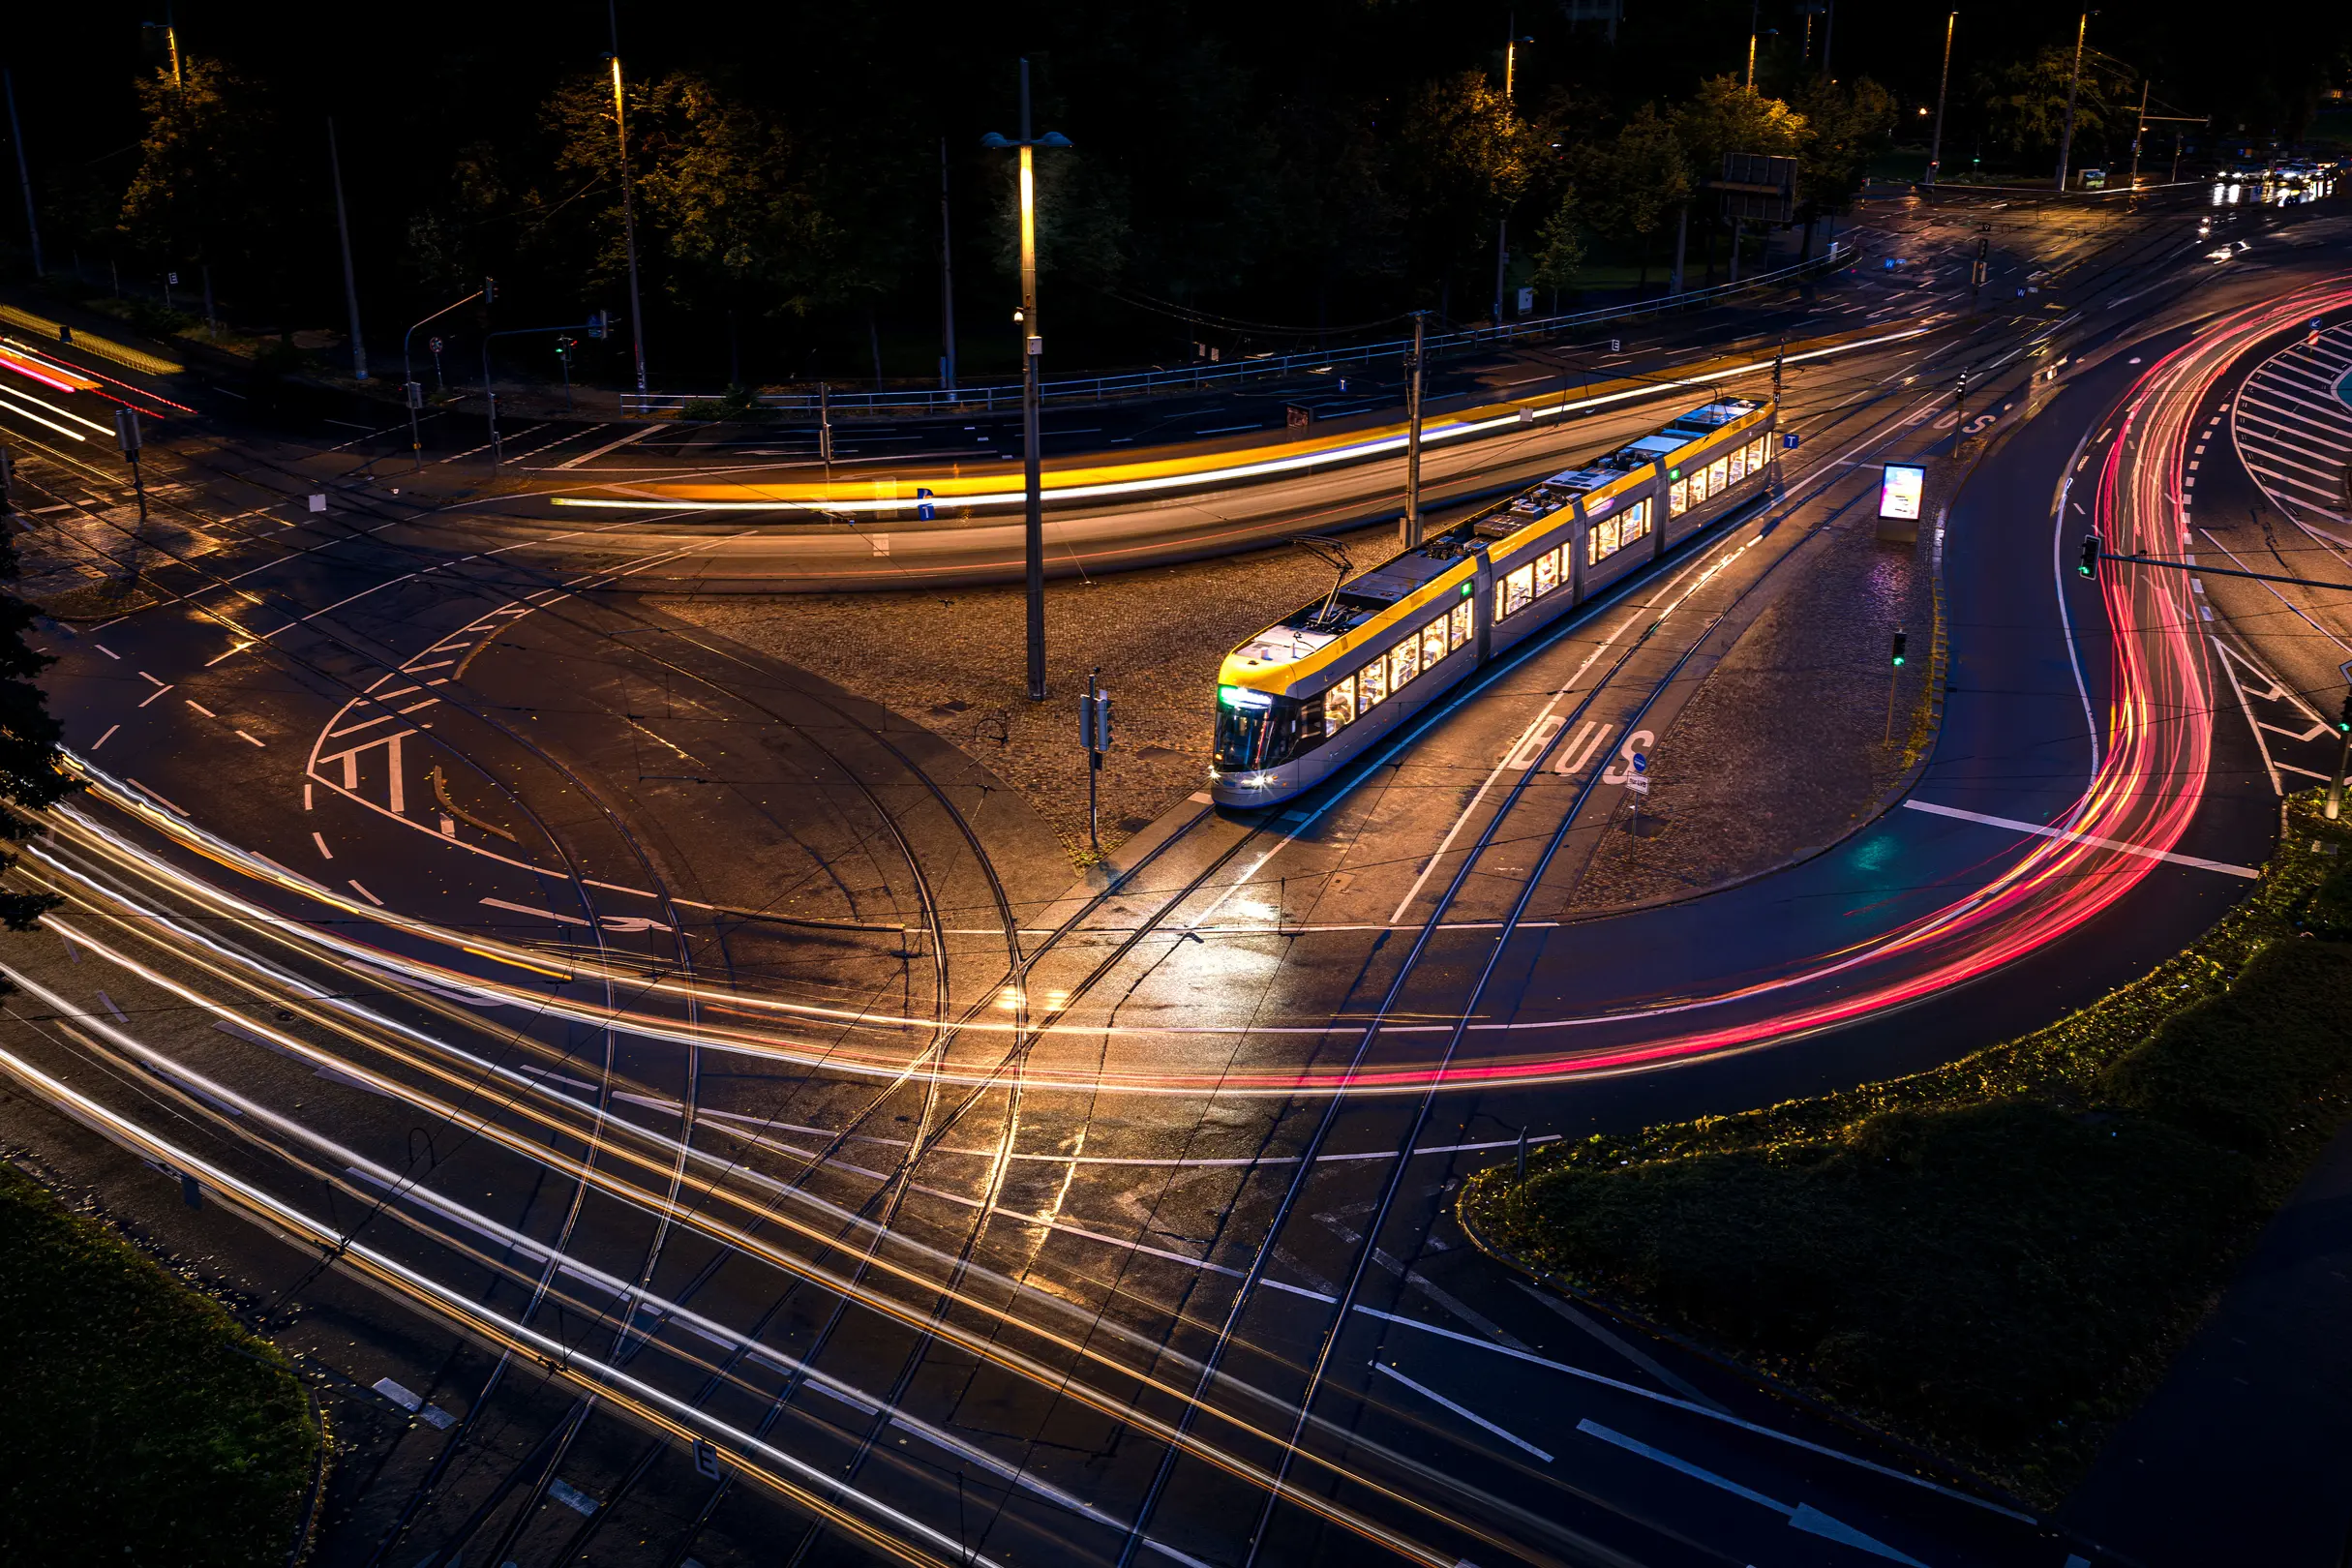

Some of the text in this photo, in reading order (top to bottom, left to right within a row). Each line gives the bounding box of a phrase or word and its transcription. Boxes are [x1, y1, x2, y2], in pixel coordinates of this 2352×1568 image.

[2017, 288, 2026, 297] W
[1340, 379, 1345, 390] T
[1903, 407, 1997, 434] BUS
[1787, 436, 1795, 446] T
[1507, 714, 1655, 785] BUS
[697, 1443, 714, 1475] E
